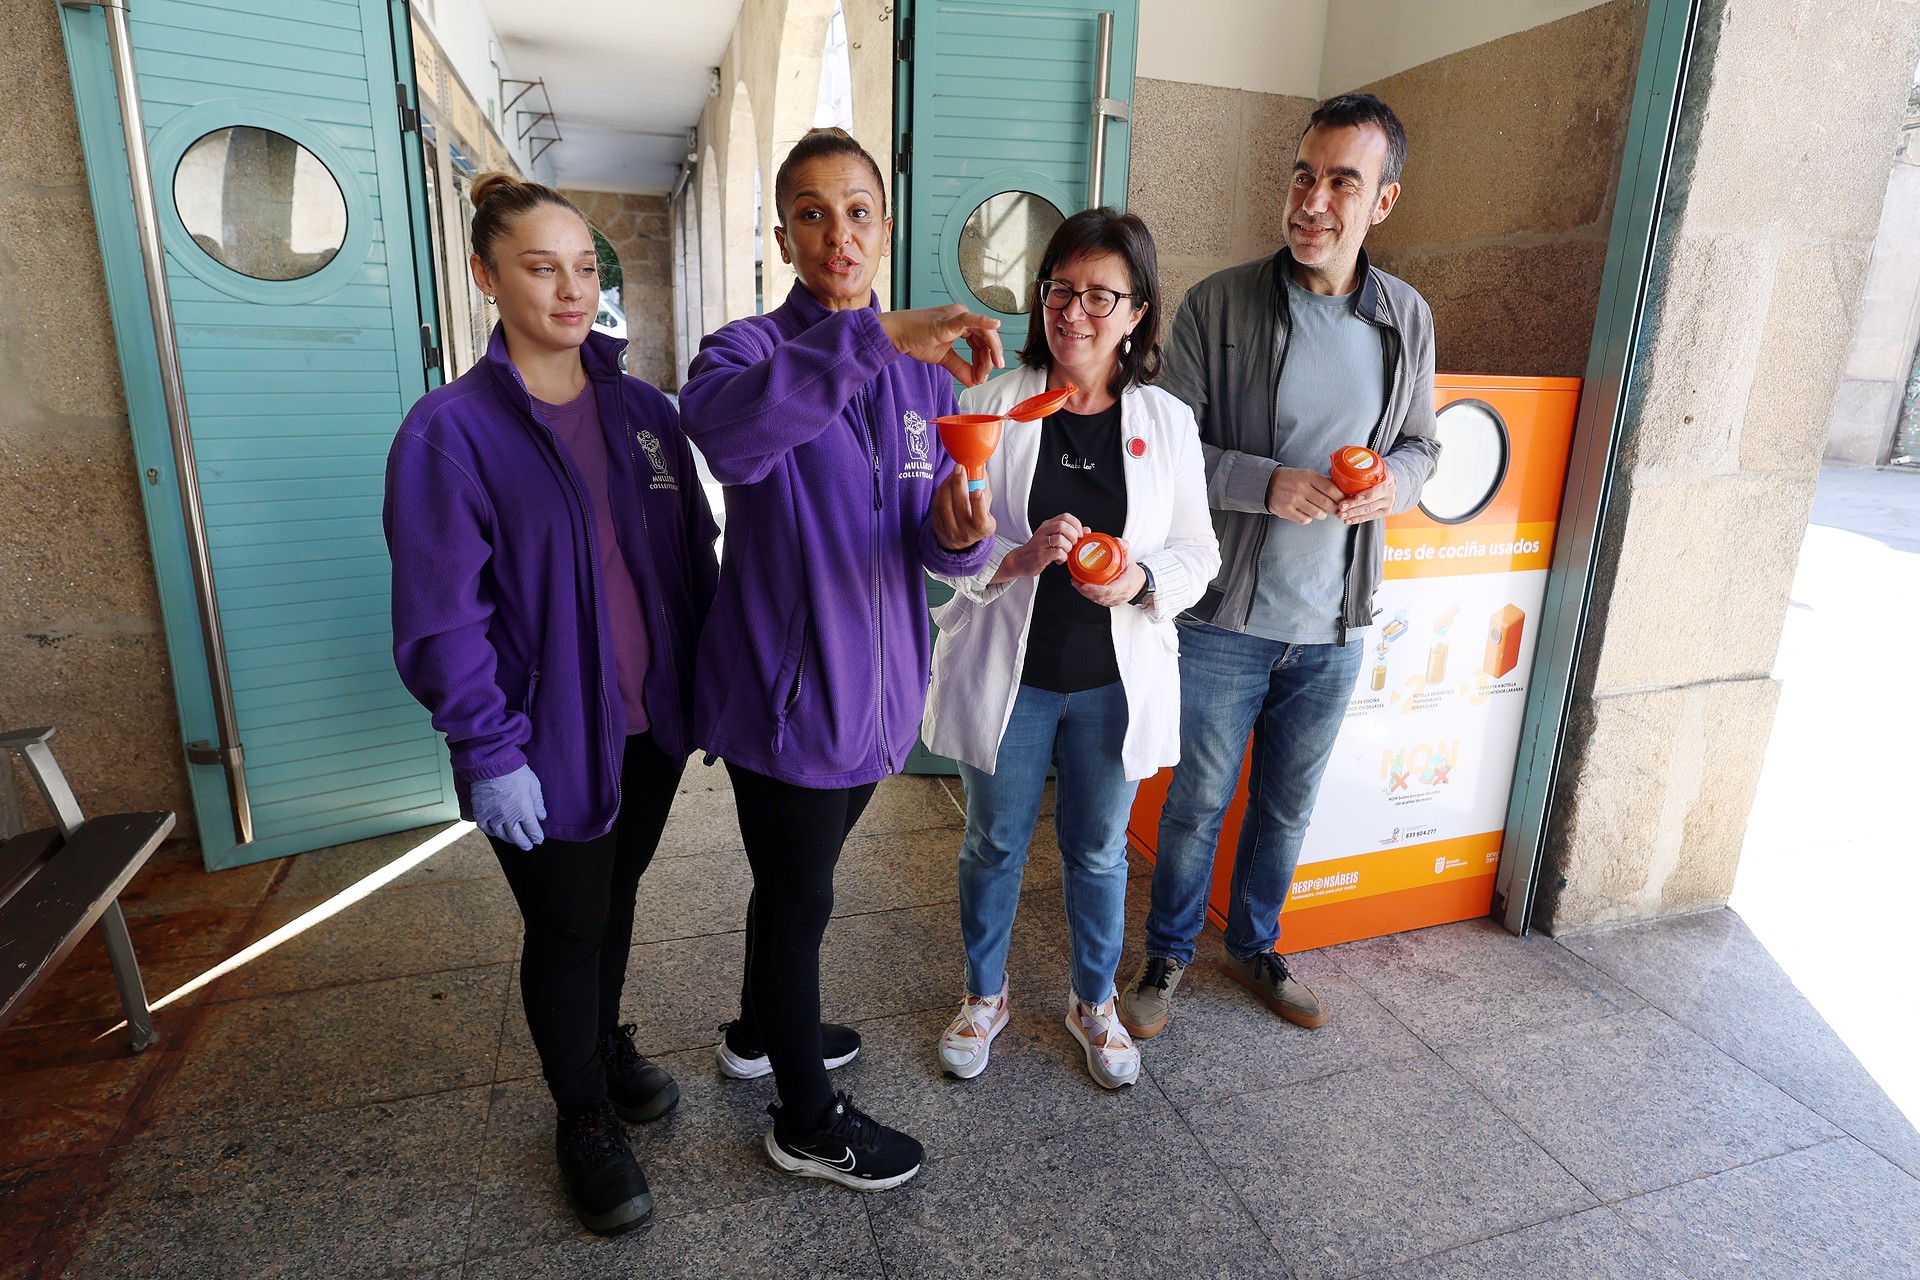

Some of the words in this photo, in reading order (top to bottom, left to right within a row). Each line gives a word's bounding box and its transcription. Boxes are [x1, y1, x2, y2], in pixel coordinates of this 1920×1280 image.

[1414, 543, 1436, 561] de
[1438, 540, 1486, 559] cociña
[1489, 537, 1540, 556] usados
